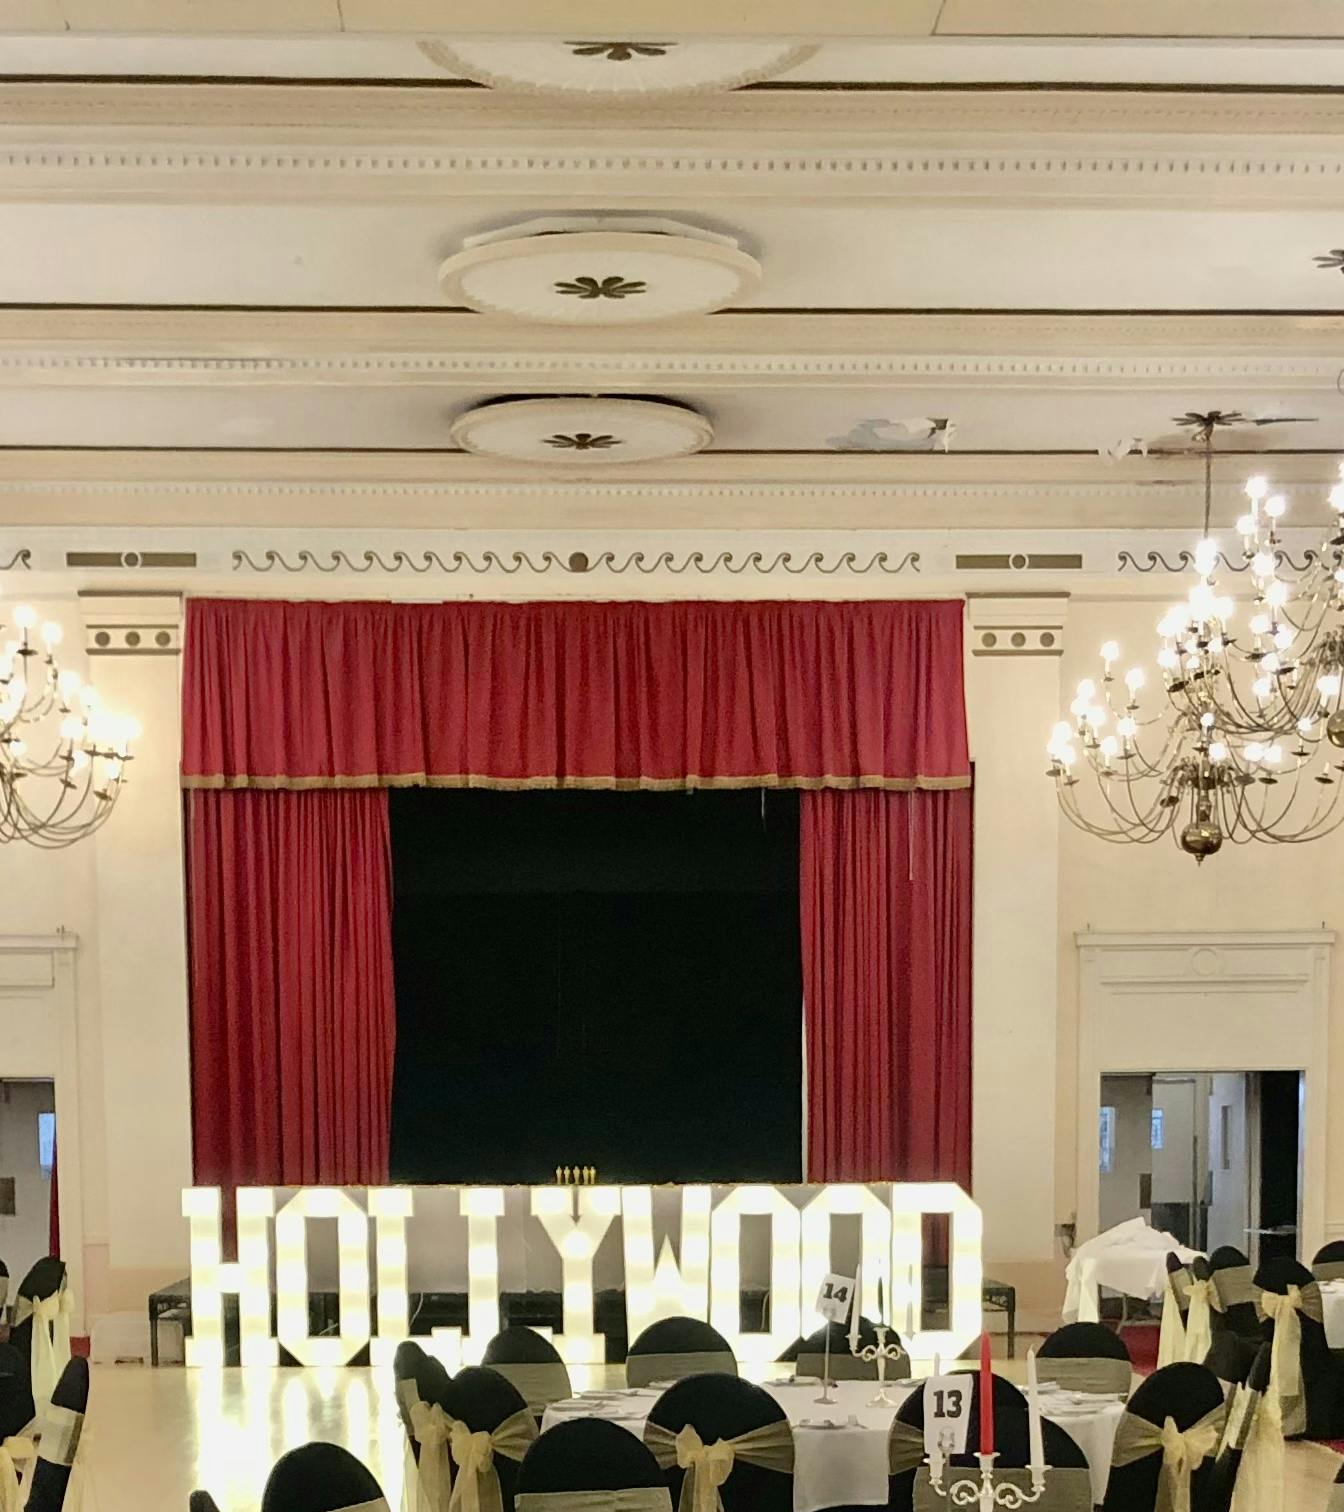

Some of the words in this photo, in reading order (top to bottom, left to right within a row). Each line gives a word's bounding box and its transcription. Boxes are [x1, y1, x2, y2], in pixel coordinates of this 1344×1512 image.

[181, 1182, 983, 1366] HOLLYWOOD
[823, 1282, 849, 1303] 14
[933, 1389, 963, 1418] 13
